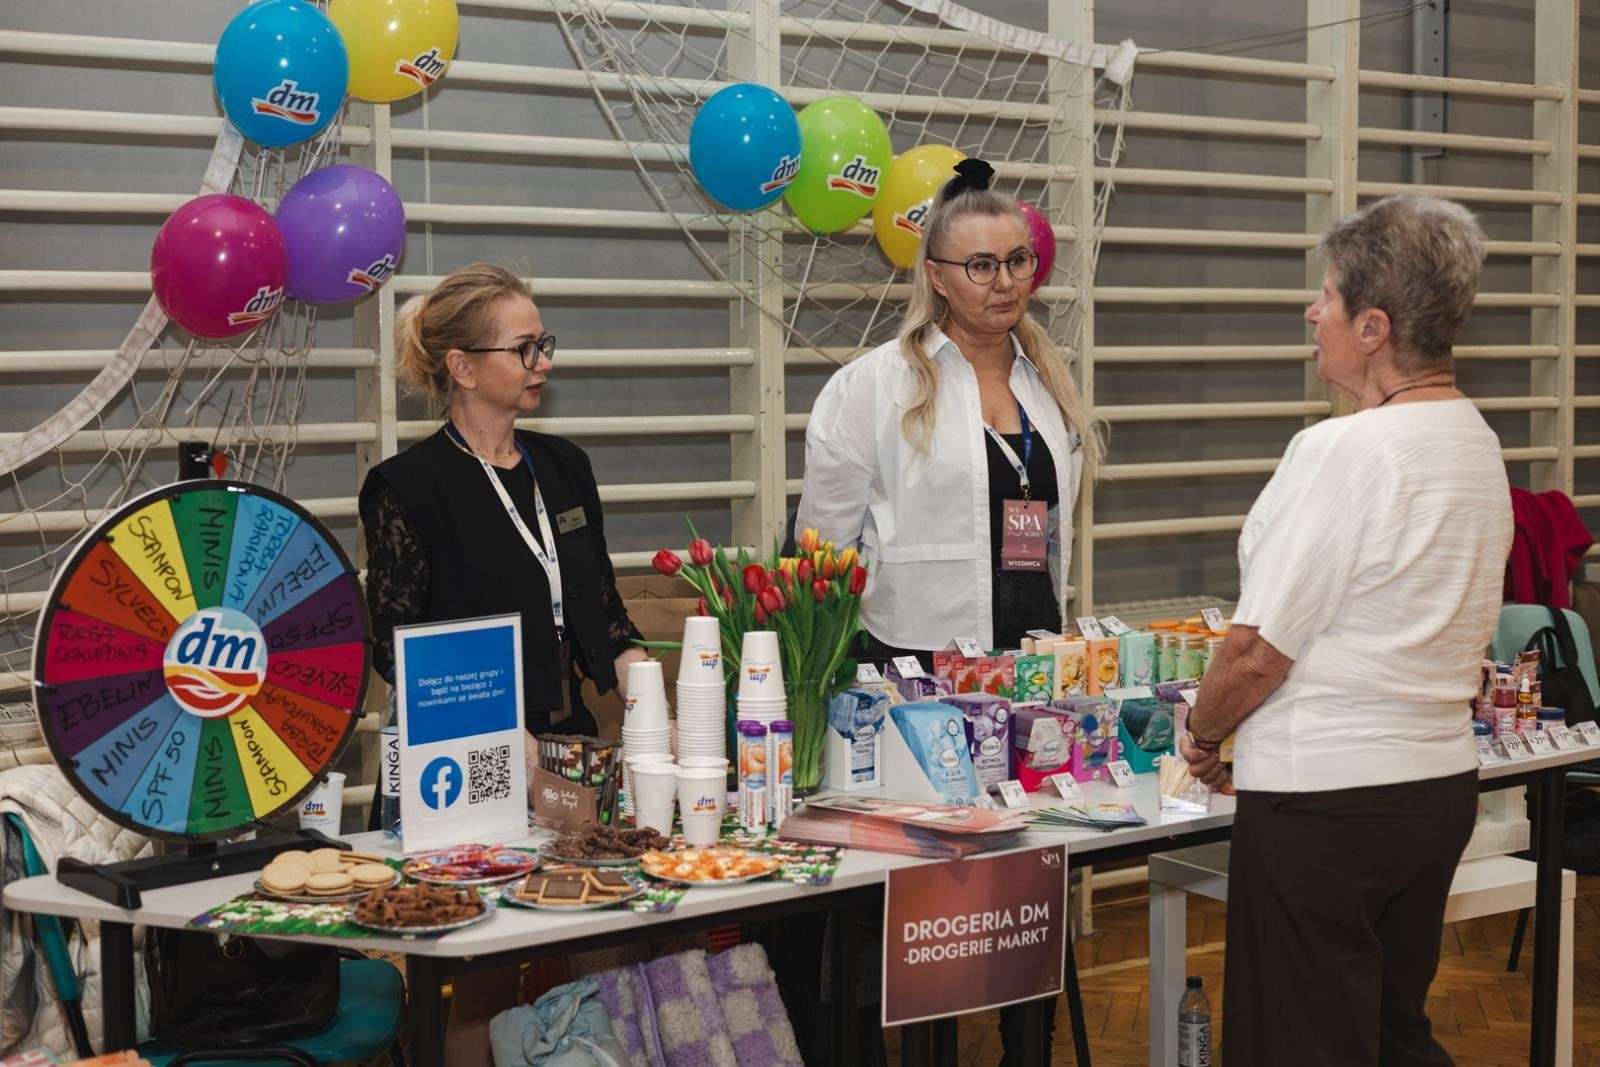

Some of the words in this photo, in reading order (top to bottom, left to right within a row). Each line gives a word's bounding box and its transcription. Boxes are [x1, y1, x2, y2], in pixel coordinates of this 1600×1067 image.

[414, 50, 445, 76] dm
[268, 83, 318, 112] dm
[772, 155, 801, 182] dm
[842, 158, 878, 186] dm
[246, 287, 284, 314] dm
[1008, 514, 1042, 531] SPA
[197, 507, 227, 590] MINIS
[254, 514, 294, 577] TORBA
[90, 559, 168, 637] SYLVECO
[256, 541, 331, 626] EBELIN
[176, 616, 257, 671] dm
[444, 675, 454, 683] do
[455, 671, 478, 681] naszej
[479, 669, 499, 680] grupy
[702, 658, 720, 669] dm
[749, 672, 768, 683] dm
[272, 659, 359, 698] SYLVECO
[90, 716, 159, 787] MINIS
[141, 762, 174, 825] SPF
[165, 730, 187, 765] 50
[203, 734, 232, 819] MINIS
[945, 769, 962, 777] AQUA
[304, 801, 324, 811] dm
[697, 796, 715, 806] dm
[1041, 852, 1061, 865] SPA
[903, 908, 1014, 944] DROGERIA
[1020, 901, 1050, 925] DM
[903, 937, 994, 965] -DROGERIE
[997, 926, 1049, 951] MARKT
[1196, 1025, 1208, 1066] KINGA
